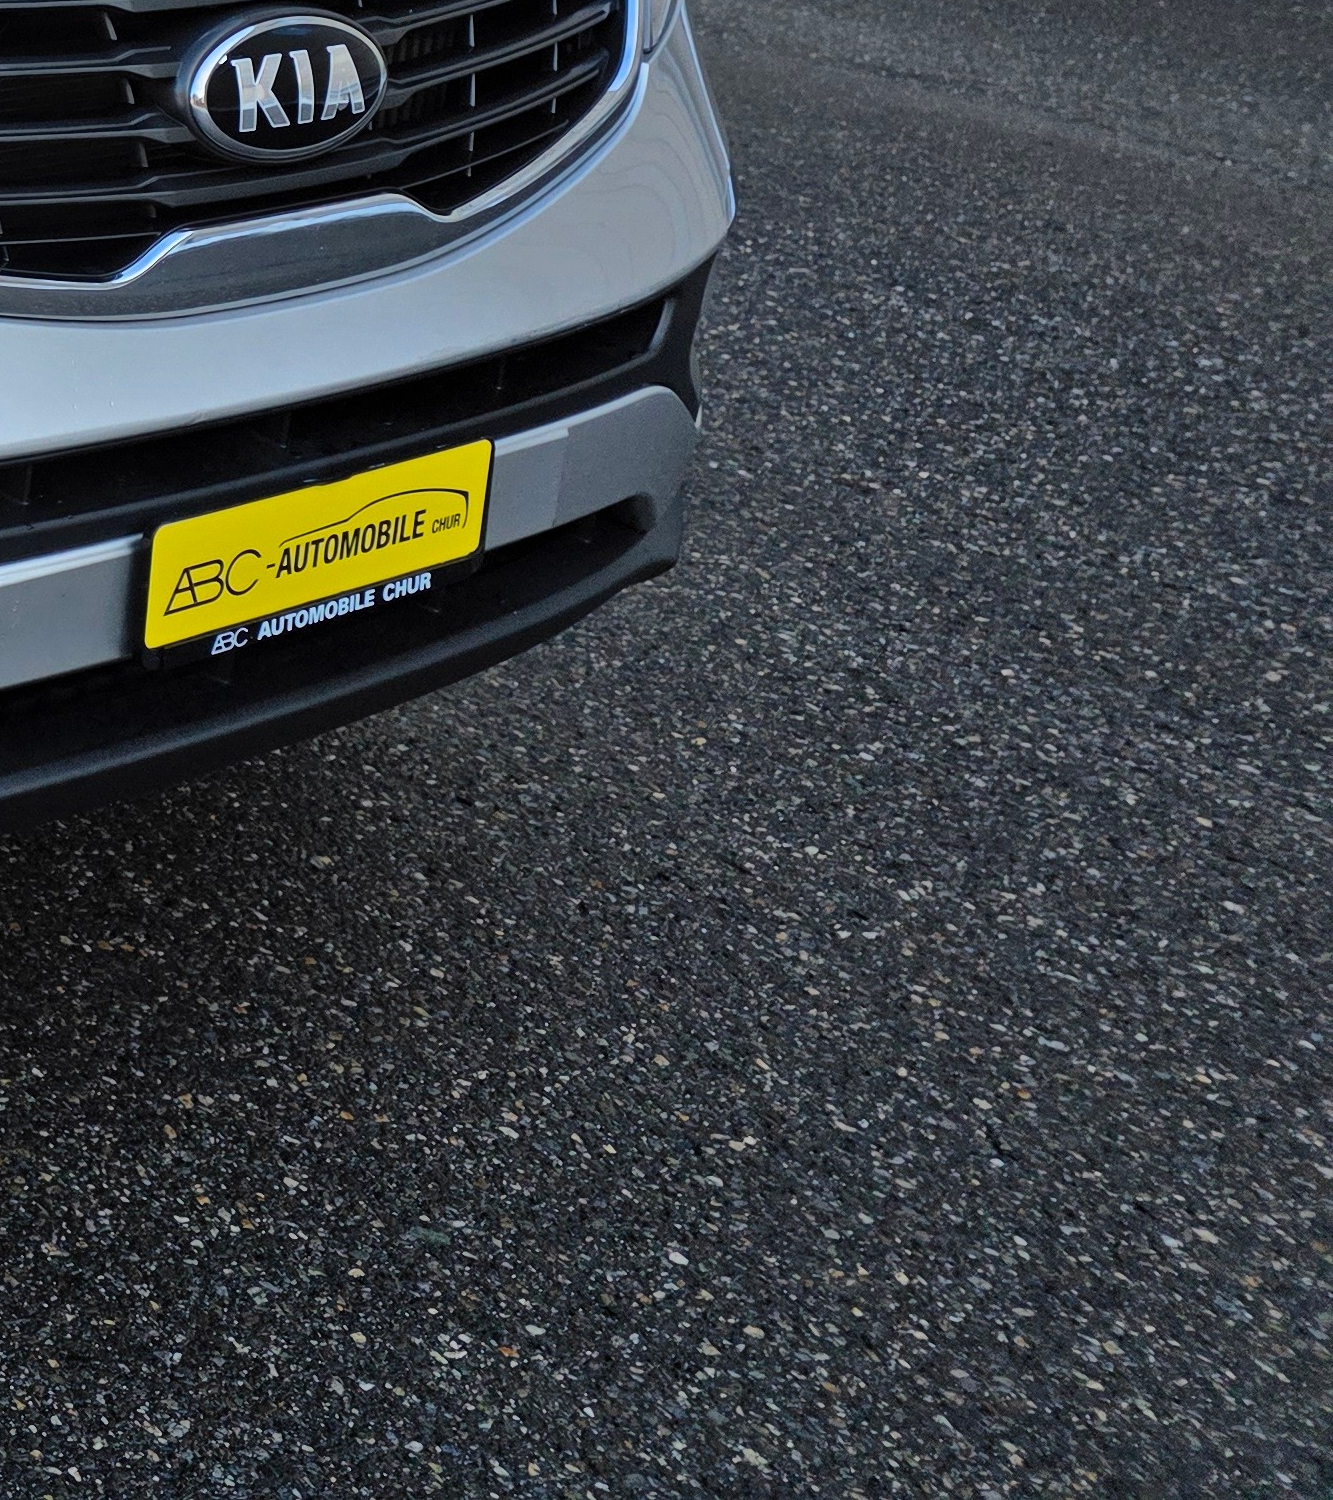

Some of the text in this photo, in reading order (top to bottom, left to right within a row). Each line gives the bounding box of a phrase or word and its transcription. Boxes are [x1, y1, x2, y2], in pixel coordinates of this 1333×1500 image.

[231, 43, 366, 133] KIA
[431, 513, 461, 535] CHUR
[210, 572, 433, 656] ABC AUTOMOBILE CHUR
